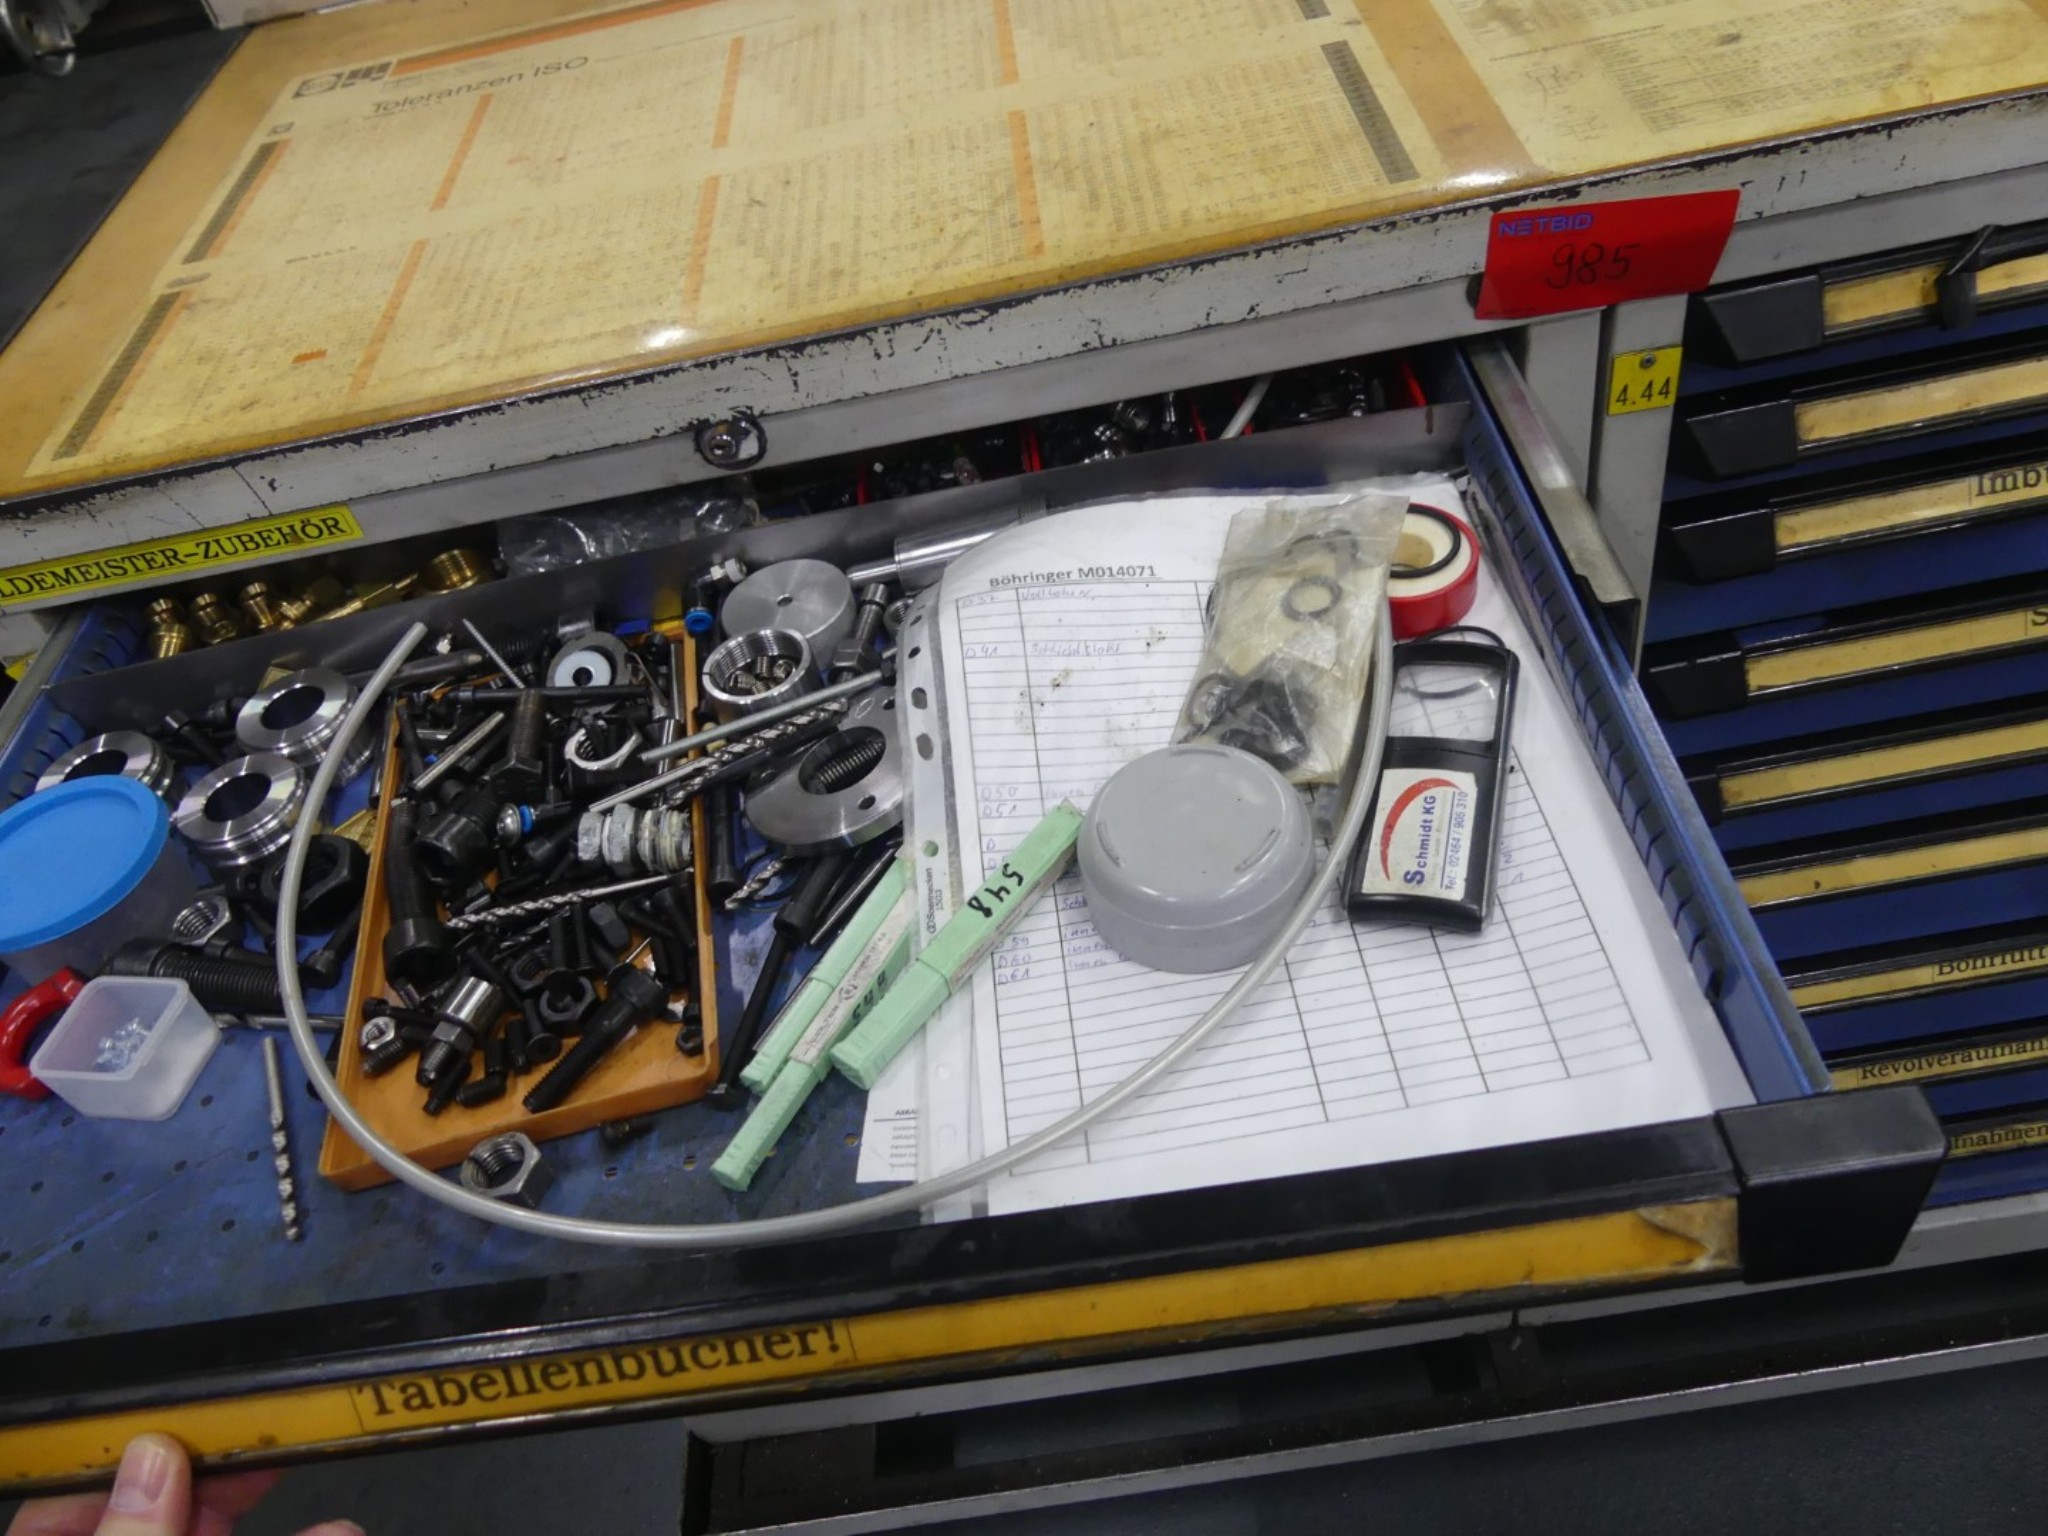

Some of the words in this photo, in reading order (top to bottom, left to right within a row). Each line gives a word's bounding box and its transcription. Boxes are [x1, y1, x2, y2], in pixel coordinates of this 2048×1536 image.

[371, 71, 525, 114] Toleranzen
[532, 55, 590, 78] ISO
[1499, 212, 1594, 237] NETBID
[1545, 243, 1641, 290] 985
[1615, 376, 1672, 408] 4.44
[1975, 464, 2048, 497] Imb
[989, 567, 1073, 589] Böhringer
[1078, 564, 1157, 580] M014071
[1403, 818, 1433, 885] Schmidt
[1422, 795, 1436, 815] KG
[967, 862, 1024, 918] 548
